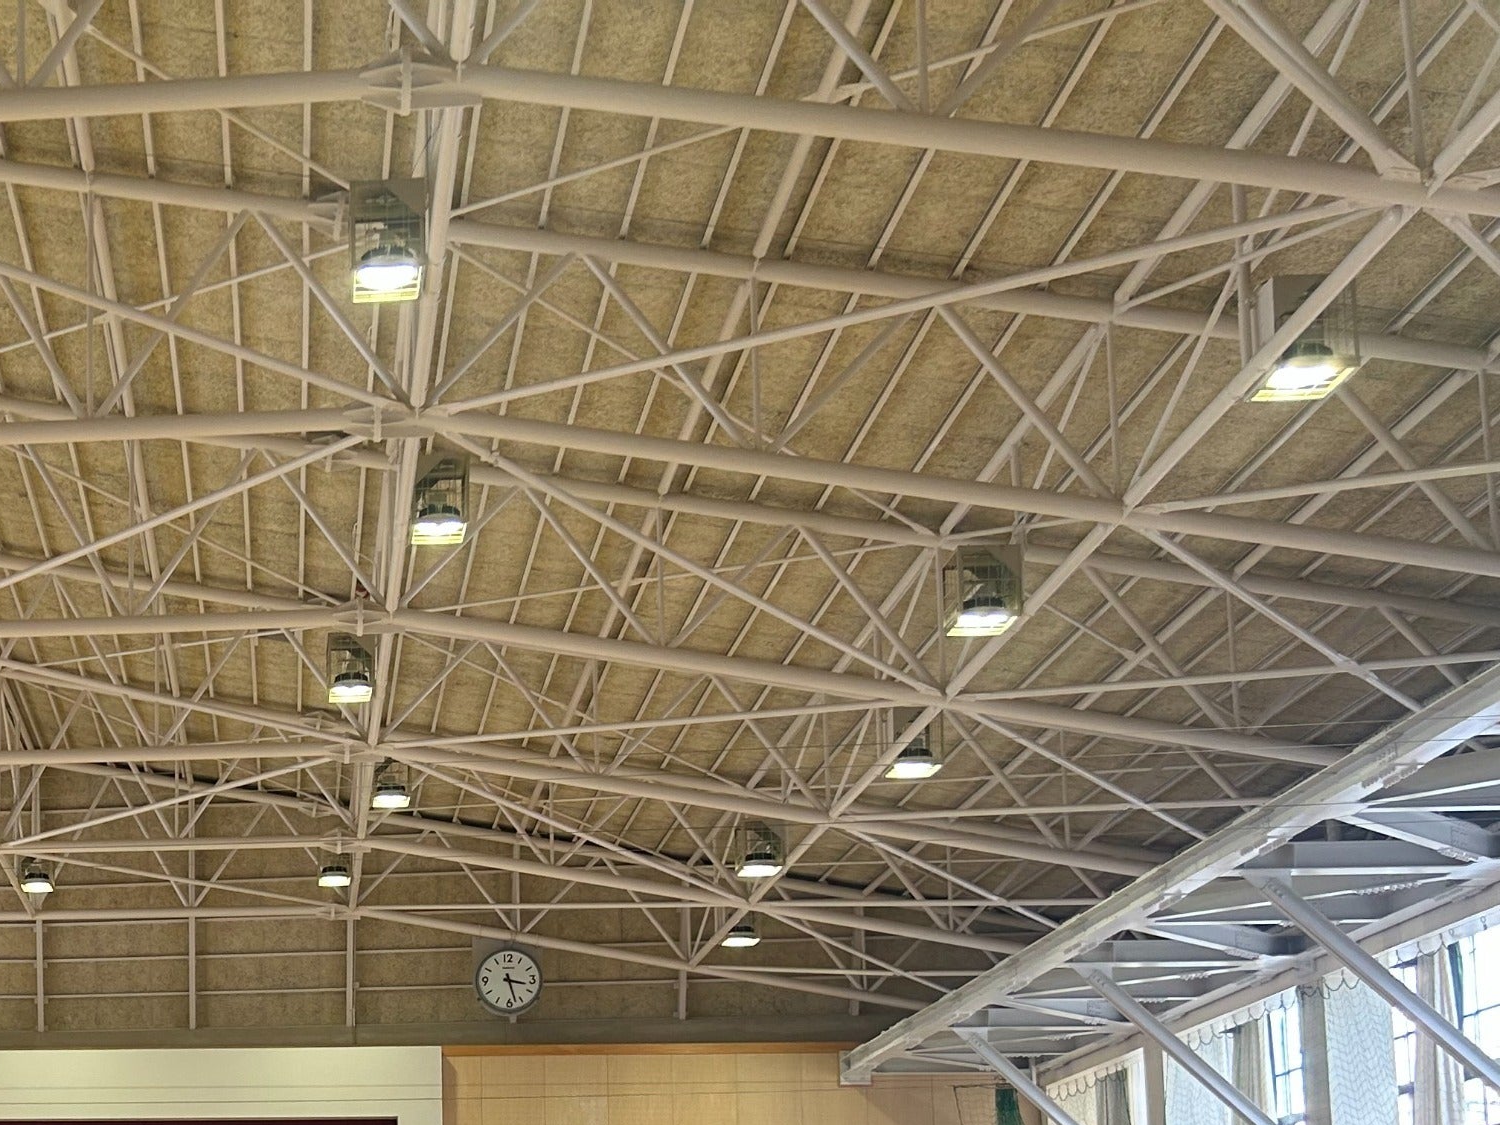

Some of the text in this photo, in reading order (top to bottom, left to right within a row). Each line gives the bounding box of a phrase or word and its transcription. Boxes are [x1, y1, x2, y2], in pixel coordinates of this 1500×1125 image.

[503, 954, 513, 963] 12
[481, 976, 489, 986] 9
[529, 975, 536, 985] 3
[506, 998, 513, 1008] 6
